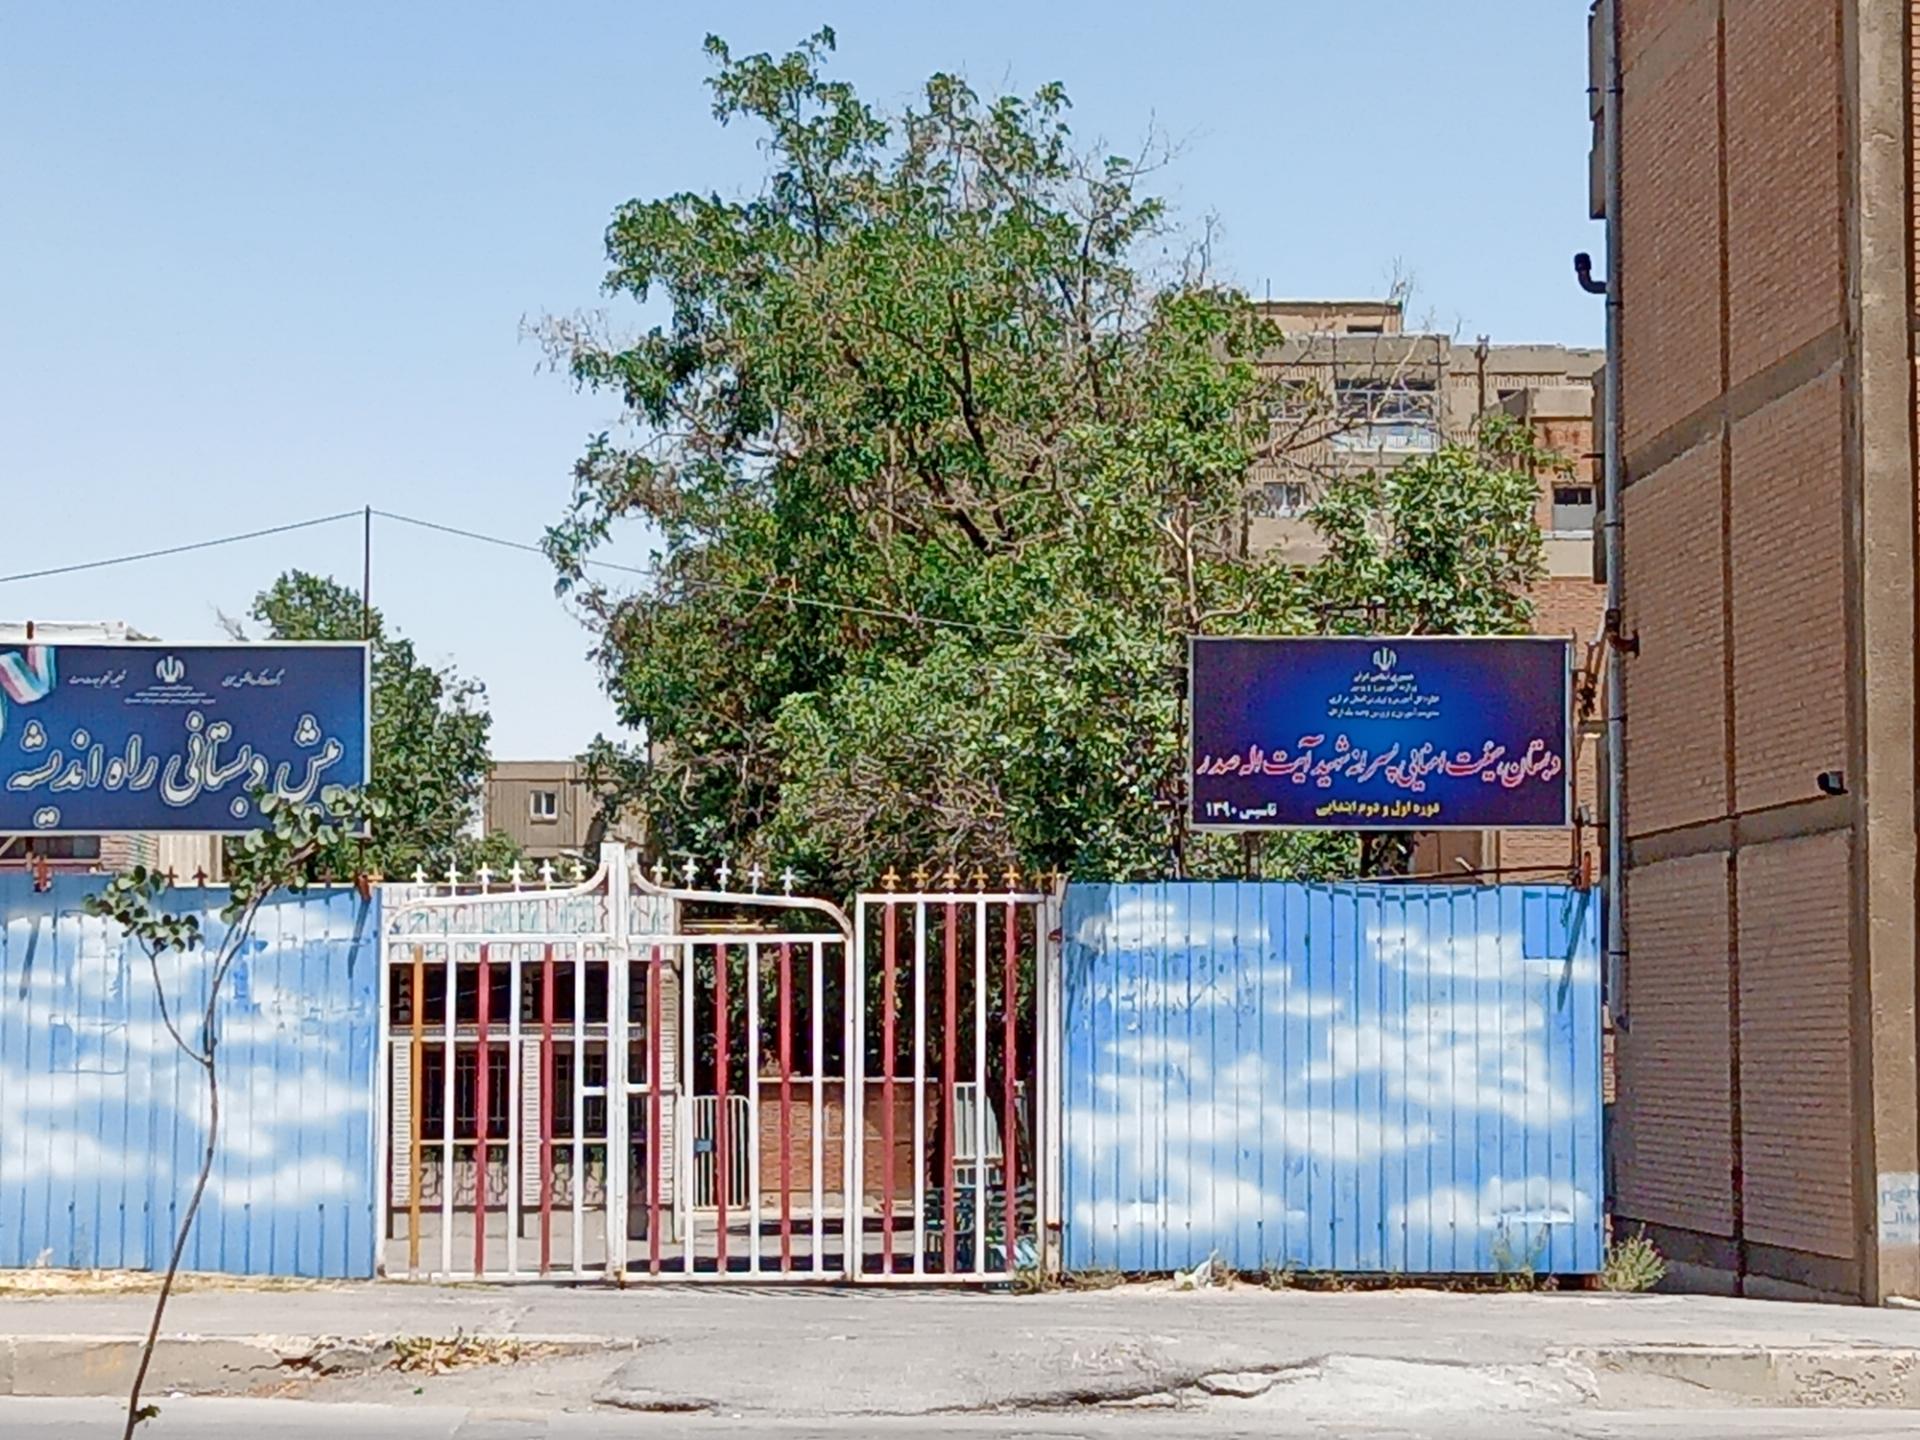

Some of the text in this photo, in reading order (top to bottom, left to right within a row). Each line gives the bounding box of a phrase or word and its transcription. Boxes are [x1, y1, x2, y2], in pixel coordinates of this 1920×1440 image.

[6, 719, 103, 828] اندیشه
[104, 733, 159, 791] راه
[160, 711, 269, 819] دبستانی
[1196, 753, 1241, 775] صدر
[1262, 734, 1326, 783] آیت
[1310, 734, 1350, 788] شهید
[1345, 742, 1400, 783] پسرانه
[1501, 738, 1562, 788] دبستان
[1315, 799, 1440, 817] دوره اول و دوم ابتدایی
